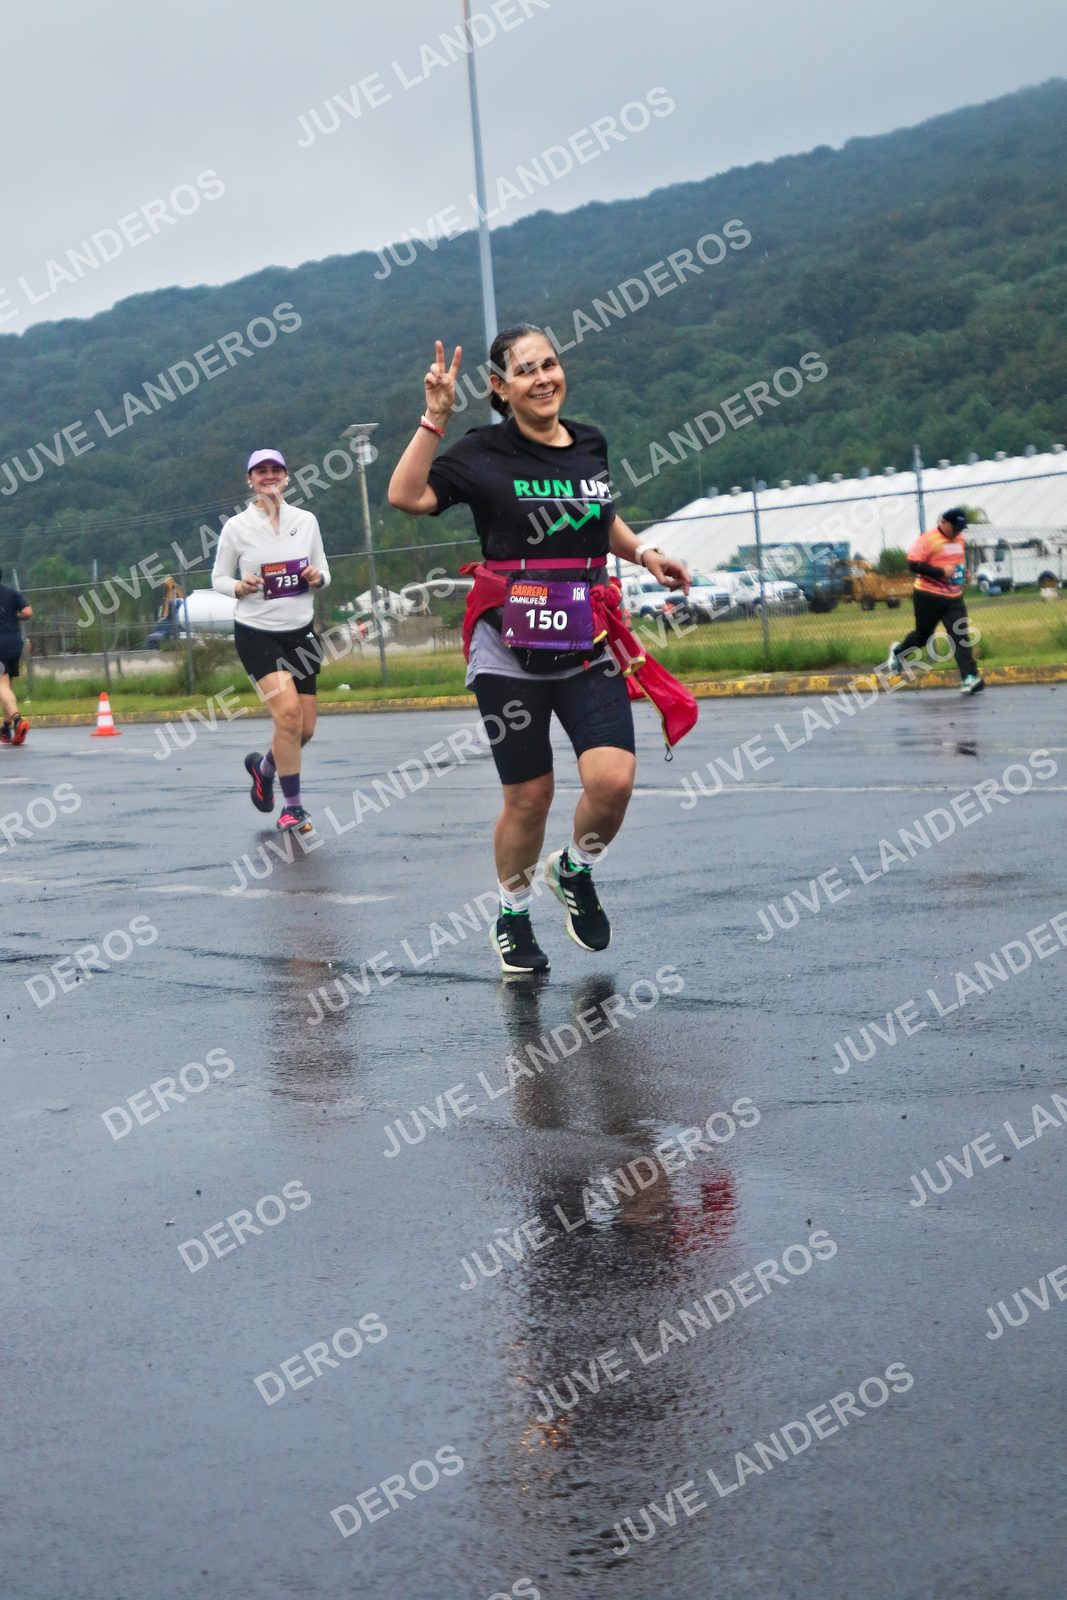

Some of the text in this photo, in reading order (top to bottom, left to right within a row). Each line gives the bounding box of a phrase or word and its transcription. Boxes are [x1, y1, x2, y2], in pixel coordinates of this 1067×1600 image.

[514, 479, 574, 496] RUN
[276, 574, 299, 588] 733
[511, 585, 549, 597] CARRERA
[526, 609, 568, 630] 150
